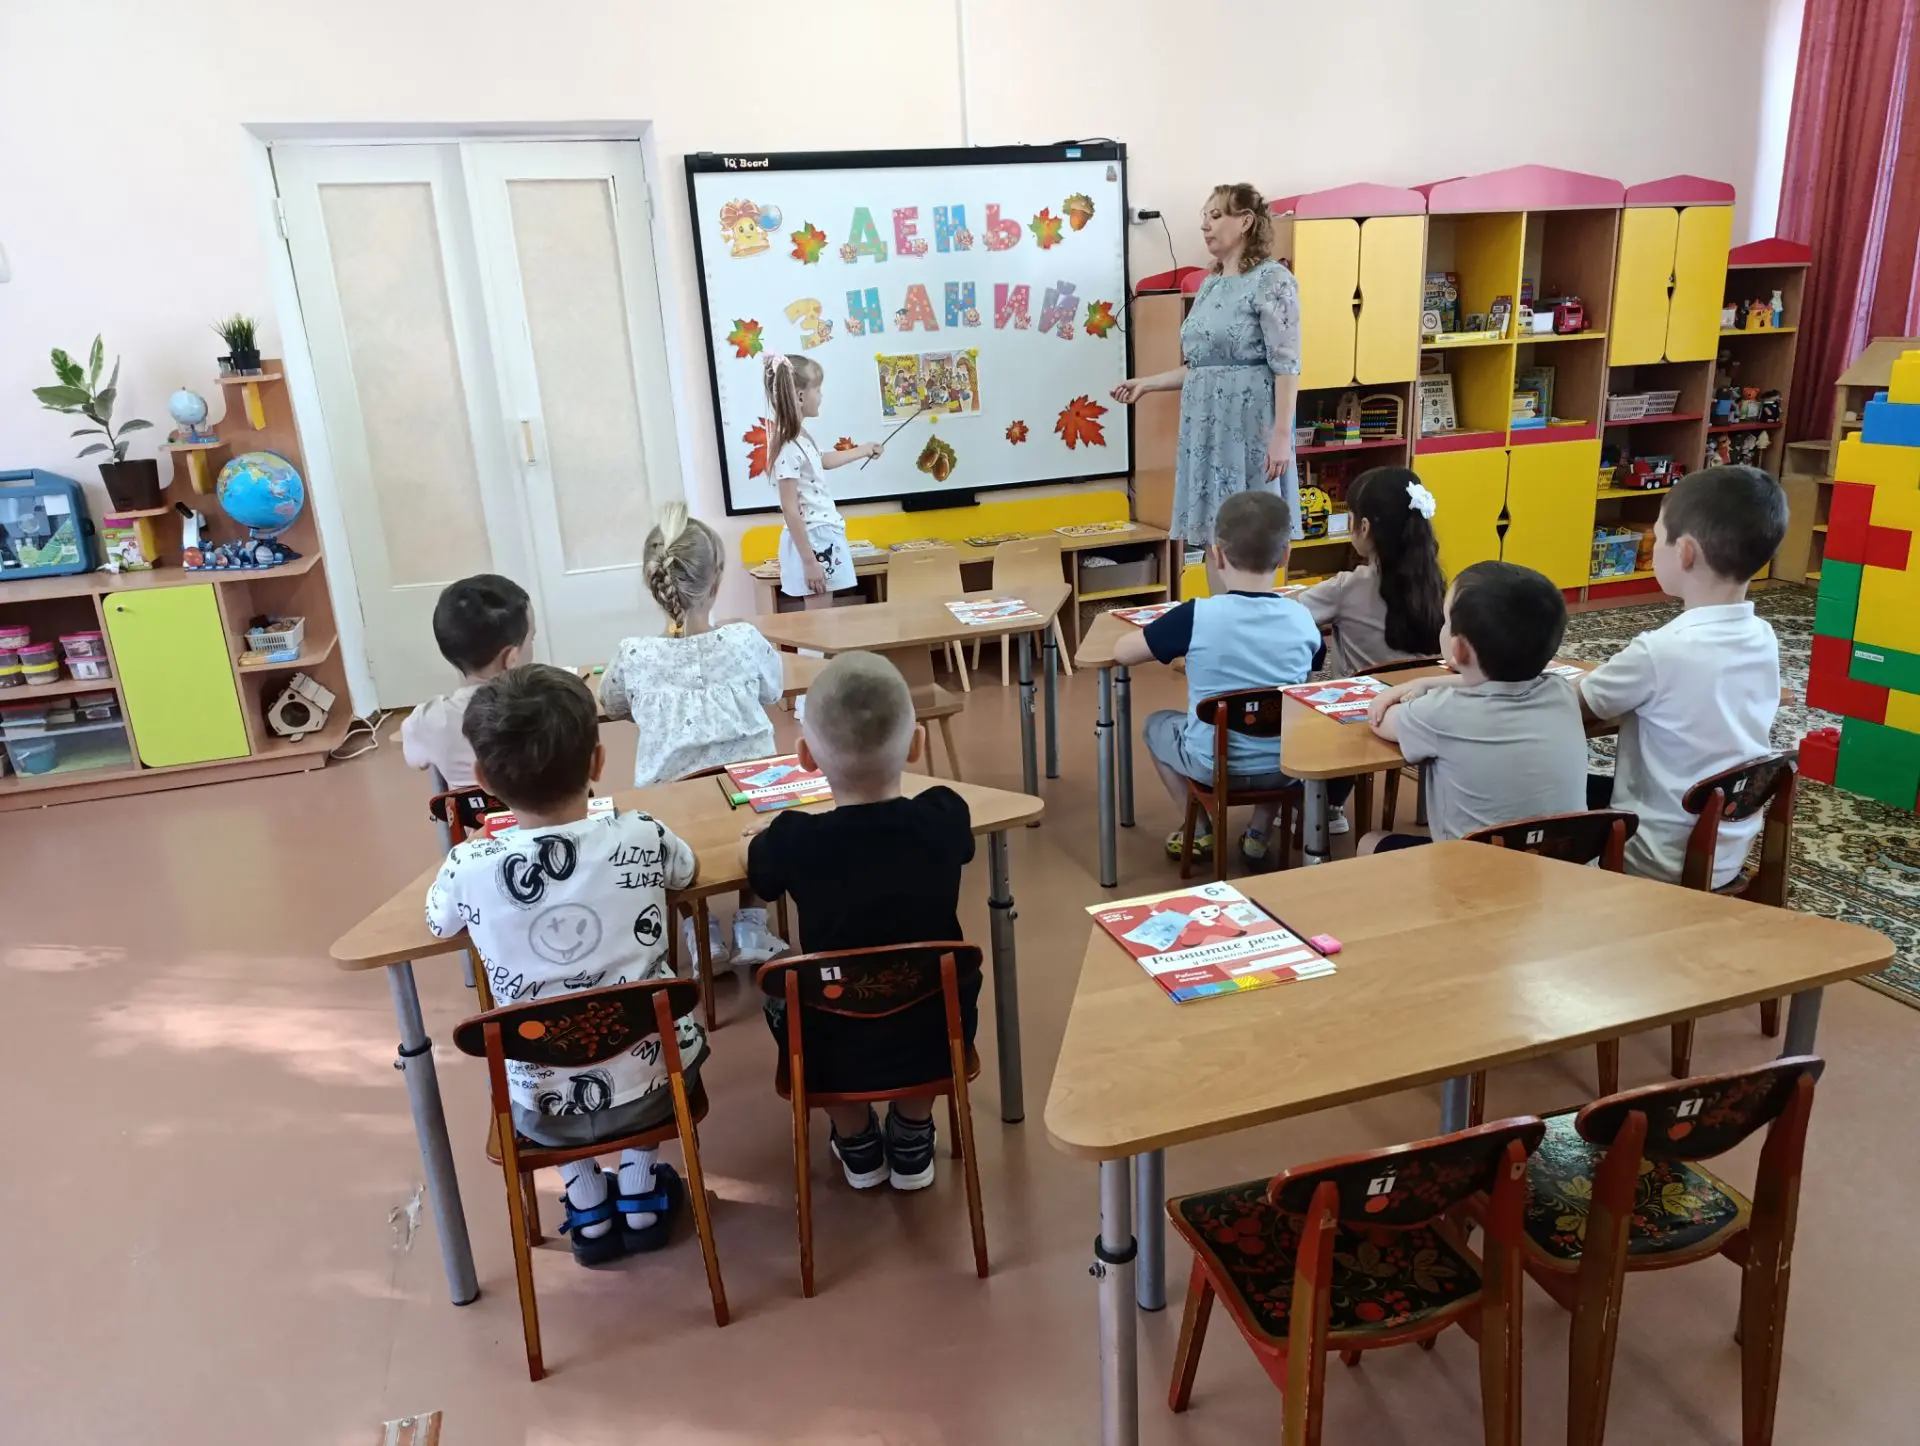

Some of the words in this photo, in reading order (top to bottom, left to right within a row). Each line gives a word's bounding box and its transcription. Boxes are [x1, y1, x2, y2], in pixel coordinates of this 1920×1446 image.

[739, 157, 769, 168] Board
[842, 203, 1022, 264] ДЕНЬ
[783, 280, 1080, 350] ЗНАНИЙ
[503, 834, 577, 904] GO
[1152, 942, 1242, 965] Развитие
[1248, 932, 1290, 949] речи
